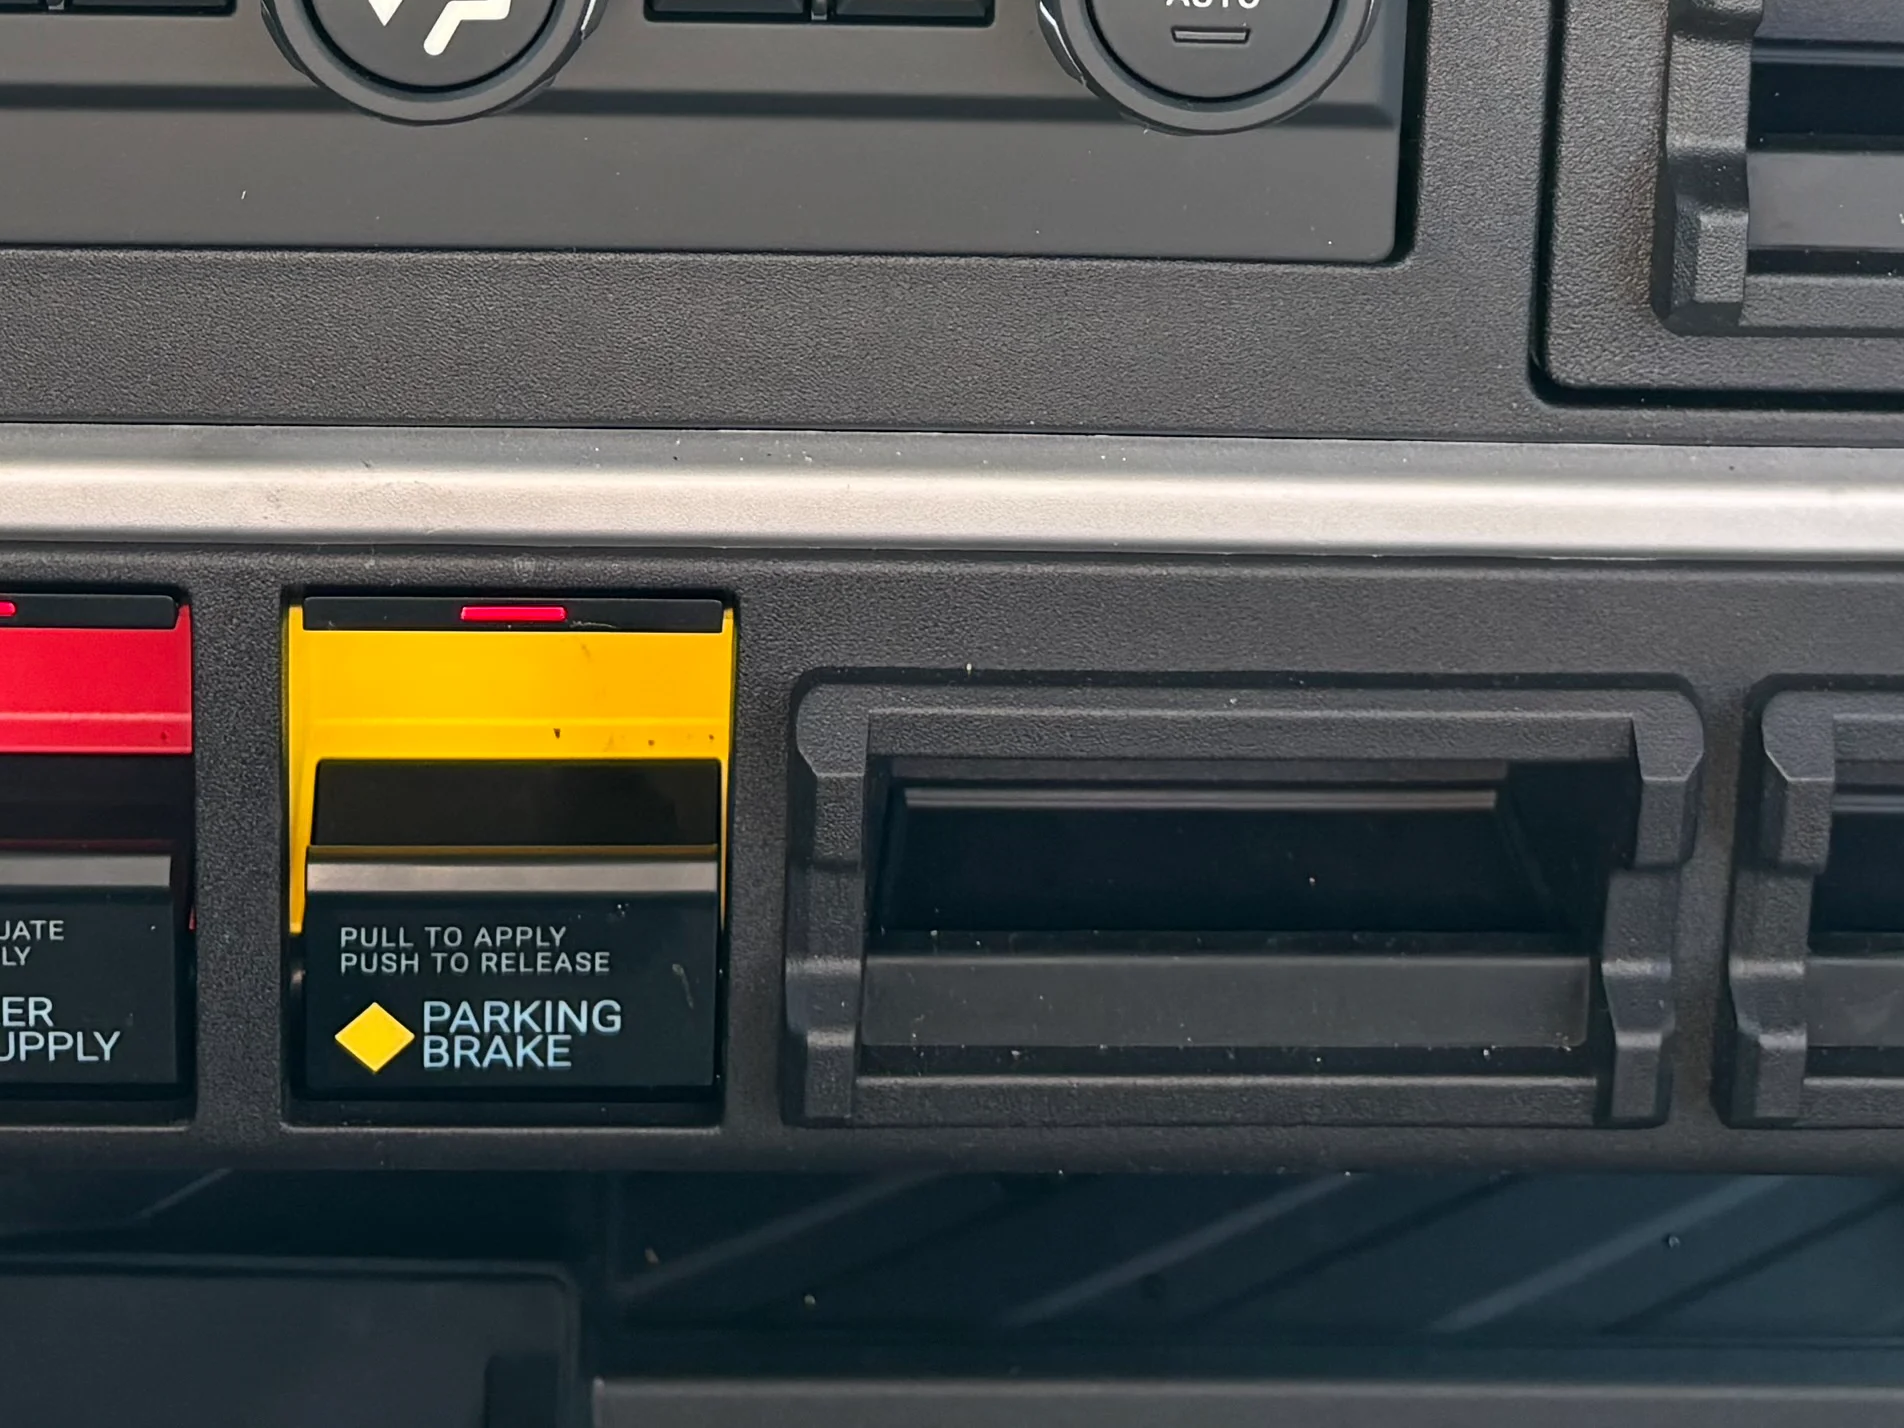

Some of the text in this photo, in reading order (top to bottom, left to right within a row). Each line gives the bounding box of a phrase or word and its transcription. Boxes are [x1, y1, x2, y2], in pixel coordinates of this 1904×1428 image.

[340, 926, 568, 949] PULL TO APPLY
[340, 951, 610, 974] PUSH TO RELEASE
[423, 999, 622, 1034] PARKING
[423, 1034, 572, 1068] BRAKE
